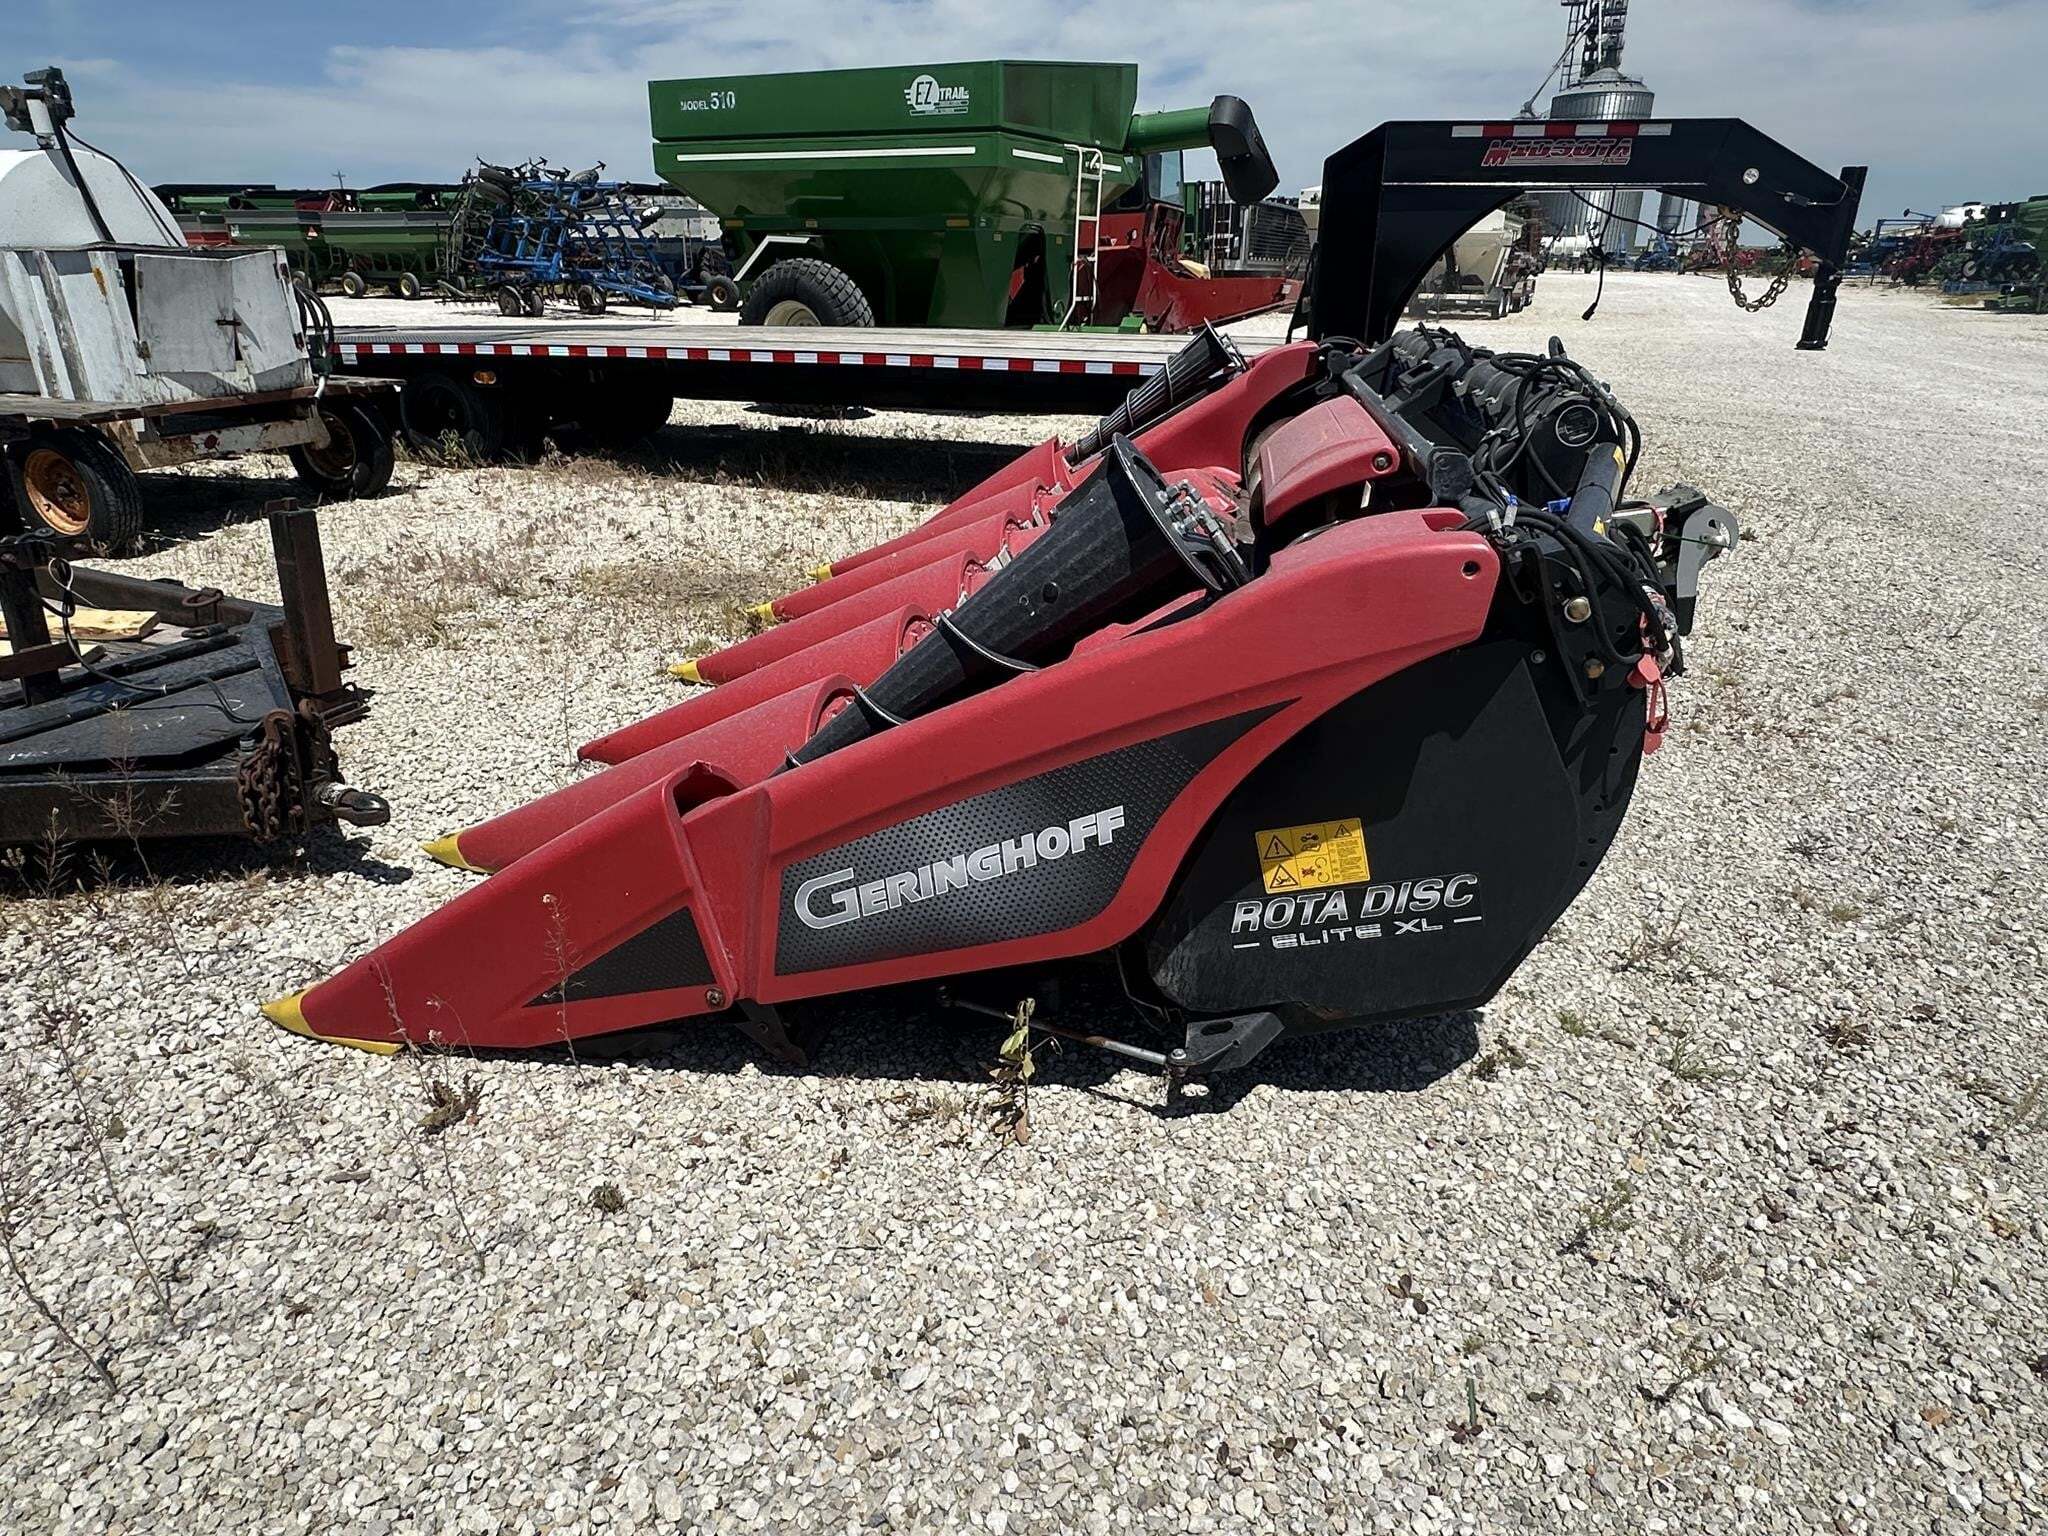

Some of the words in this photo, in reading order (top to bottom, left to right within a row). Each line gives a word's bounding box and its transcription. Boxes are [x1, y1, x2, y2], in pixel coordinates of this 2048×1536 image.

[710, 91, 736, 110] 510
[1481, 138, 1632, 167] MIDSOTA
[794, 805, 1125, 929] GERINGHOFF
[1231, 890, 1348, 933] ROTA
[1360, 874, 1478, 919] DISC
[1271, 923, 1382, 949] ELITE
[1393, 918, 1443, 935] XL
